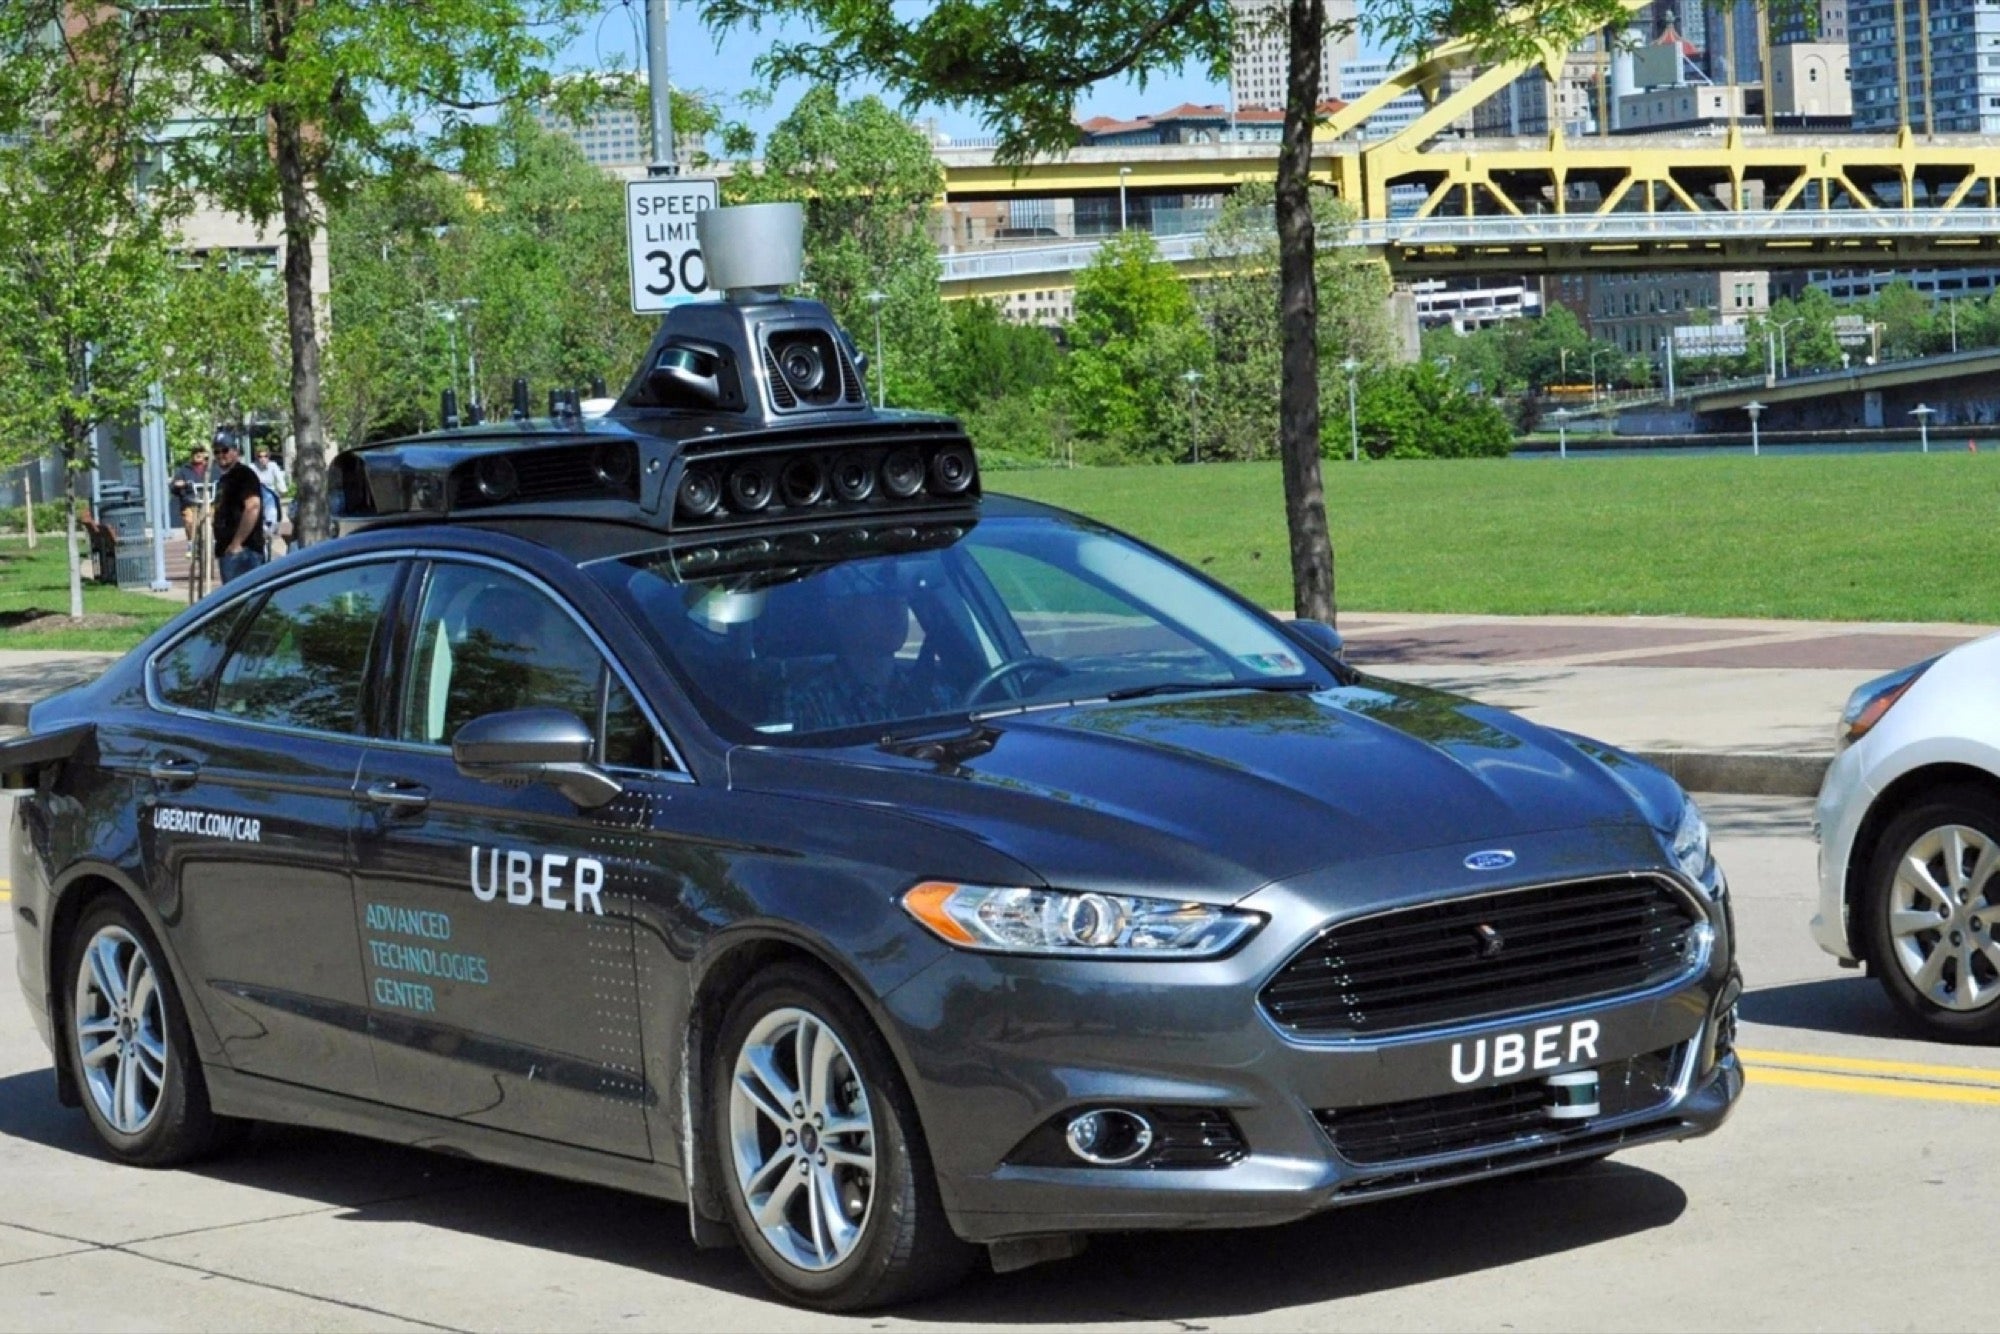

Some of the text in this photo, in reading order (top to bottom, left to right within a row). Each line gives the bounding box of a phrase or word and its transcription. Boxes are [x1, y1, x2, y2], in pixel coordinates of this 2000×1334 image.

[637, 195, 710, 216] SPEED
[645, 249, 709, 295] 30
[154, 807, 261, 842] UBERATC.COM/CAR
[470, 845, 605, 916] UBER
[366, 904, 451, 940] ADVANCED
[369, 940, 489, 984] TECHNOLOGIES
[374, 978, 436, 1012] CENTER
[1451, 1019, 1600, 1083] UBER
